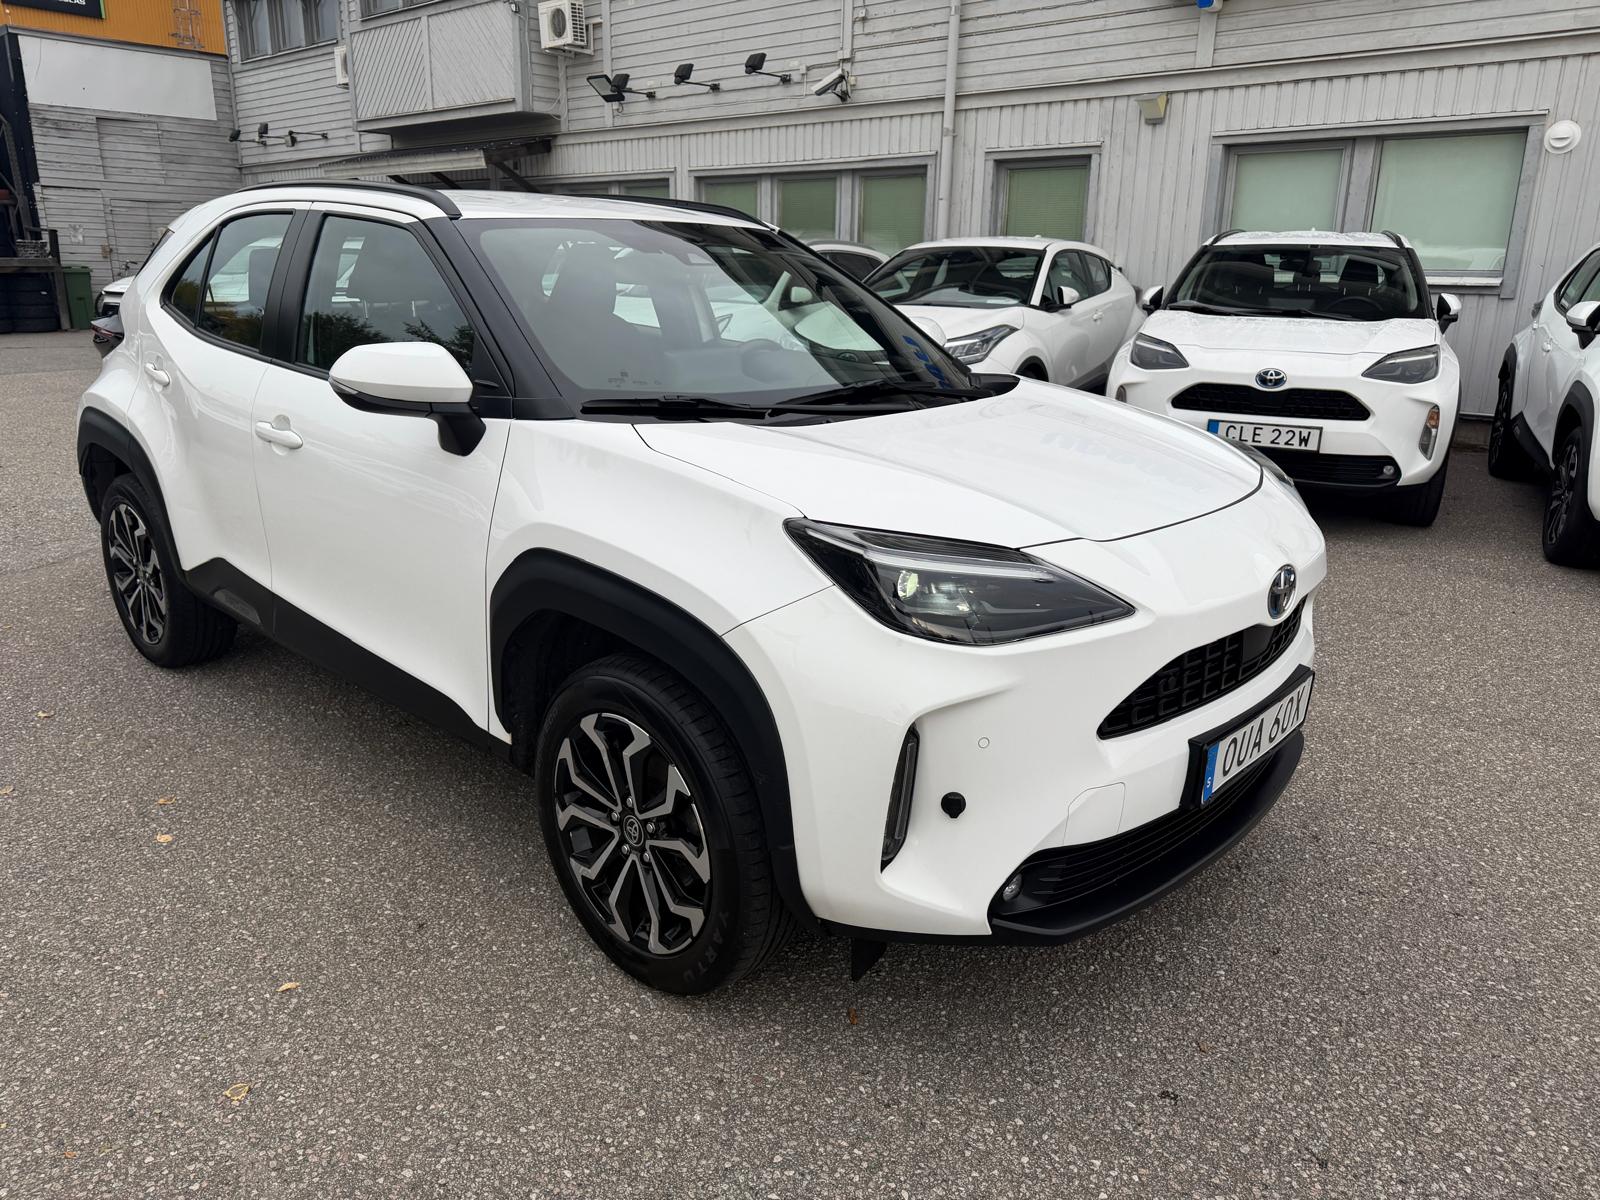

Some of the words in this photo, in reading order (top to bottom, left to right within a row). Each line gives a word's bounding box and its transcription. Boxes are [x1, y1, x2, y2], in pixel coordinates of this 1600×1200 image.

[1225, 425, 1264, 443] CLE
[1270, 428, 1312, 448] 22W
[1222, 717, 1265, 777] OUA
[1268, 685, 1306, 743] 60X
